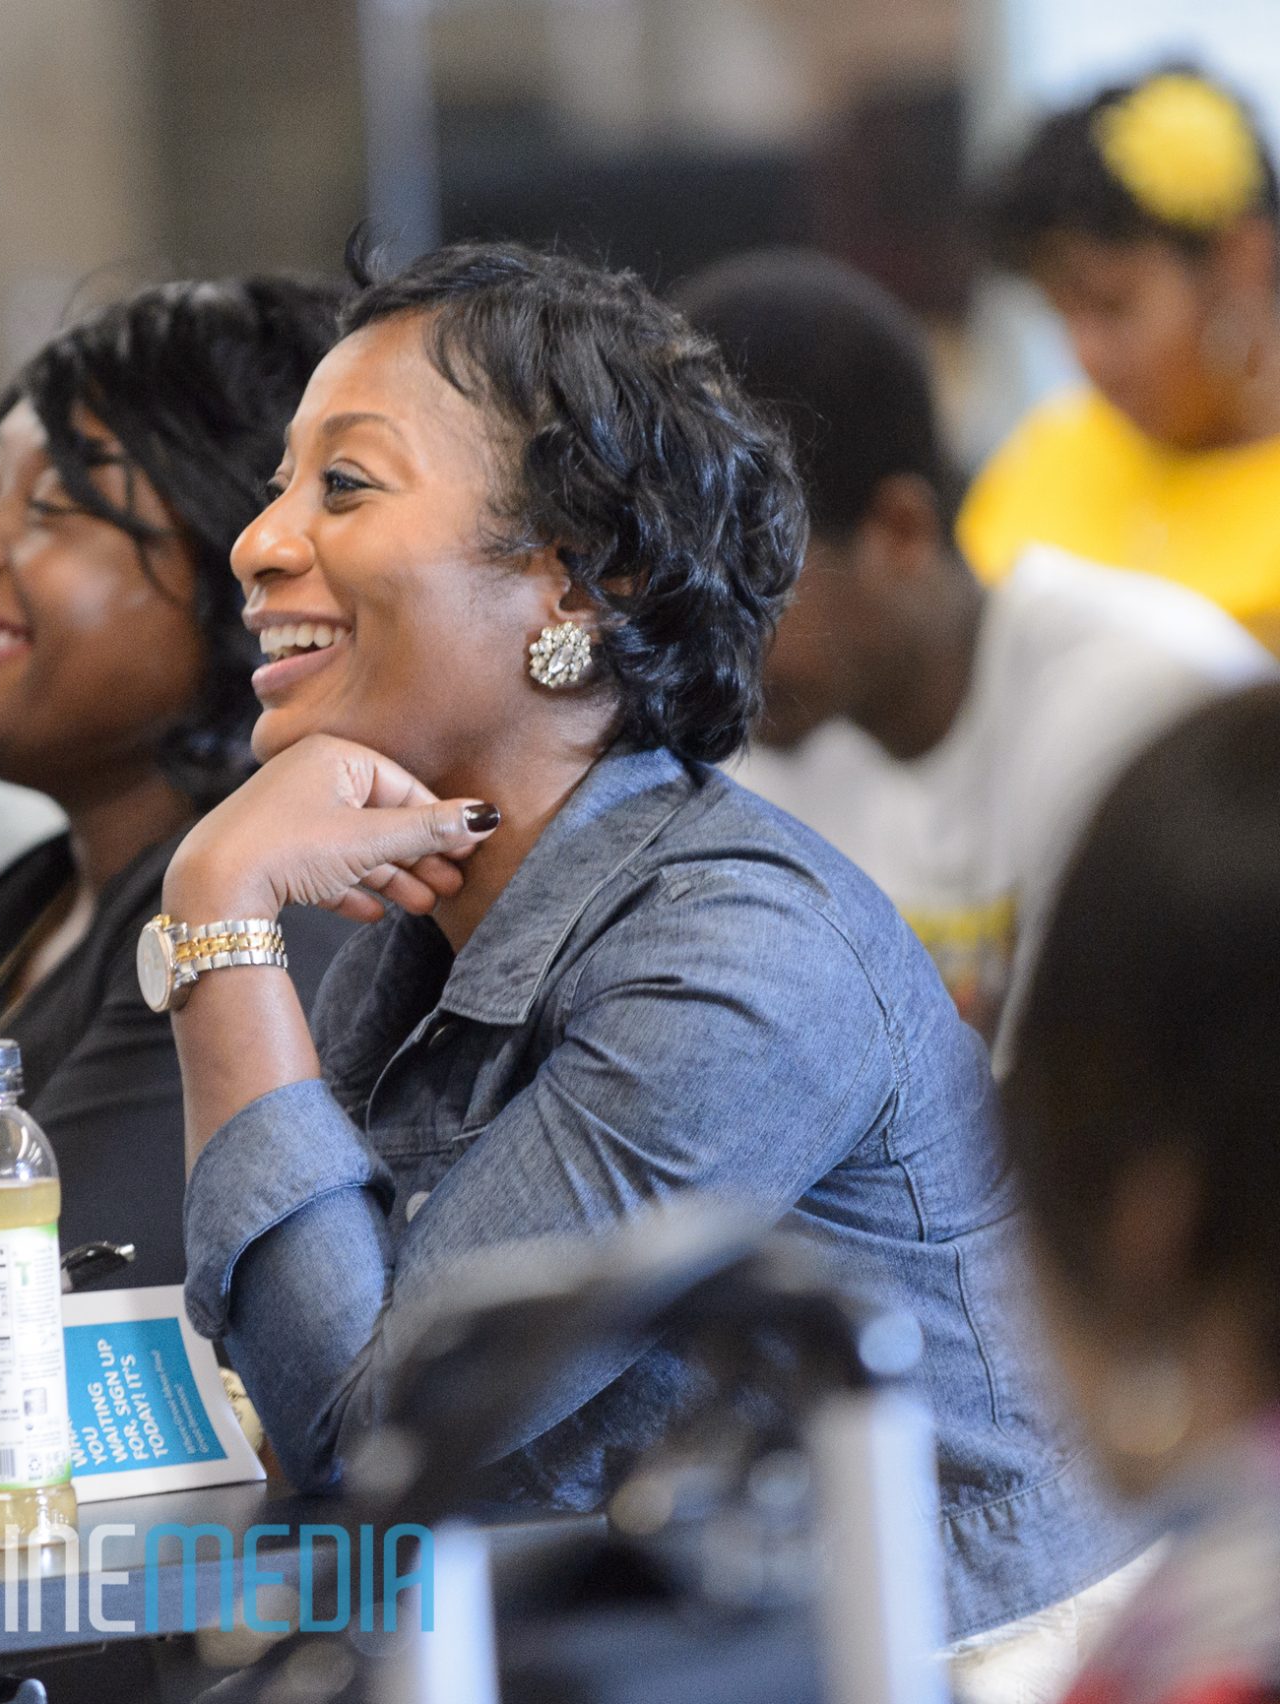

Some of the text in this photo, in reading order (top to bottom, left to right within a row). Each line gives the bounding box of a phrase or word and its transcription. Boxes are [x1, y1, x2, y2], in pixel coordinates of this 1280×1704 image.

[97, 1338, 116, 1367] UP
[104, 1371, 132, 1416] SIGN
[120, 1353, 169, 1459] TODAY! IT'S
[87, 1382, 129, 1463] WAITING
[81, 1426, 108, 1466] YOU
